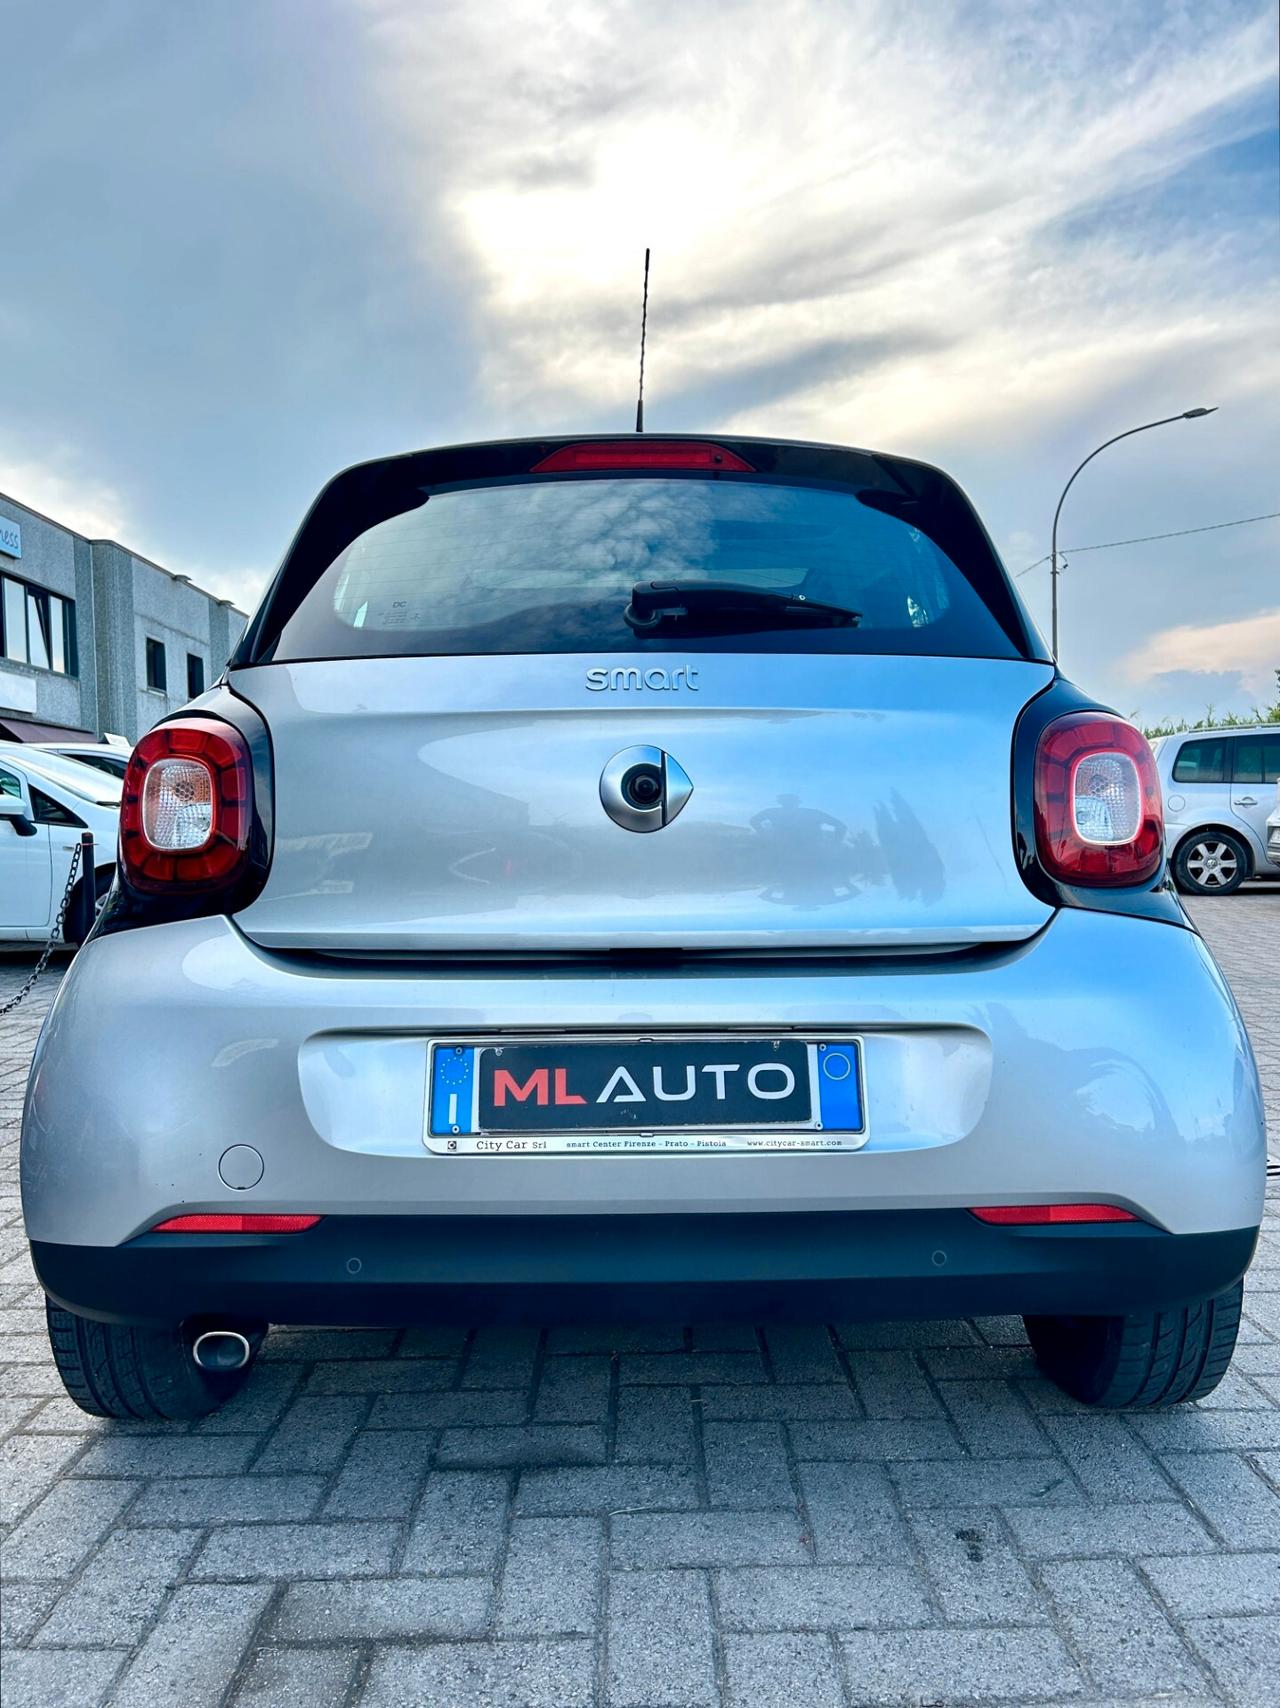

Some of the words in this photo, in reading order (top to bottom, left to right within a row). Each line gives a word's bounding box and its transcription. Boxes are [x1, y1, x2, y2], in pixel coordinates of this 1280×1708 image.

[585, 665, 699, 691] smart
[493, 1068, 587, 1107] ML
[596, 1062, 796, 1103] AUTO
[476, 1140, 502, 1151] City
[506, 1139, 528, 1150] Car
[592, 1140, 621, 1148] Center
[624, 1139, 656, 1148] Firenze
[697, 1139, 726, 1147] Pistoia
[747, 1139, 842, 1147] www.citycar-smart.com
